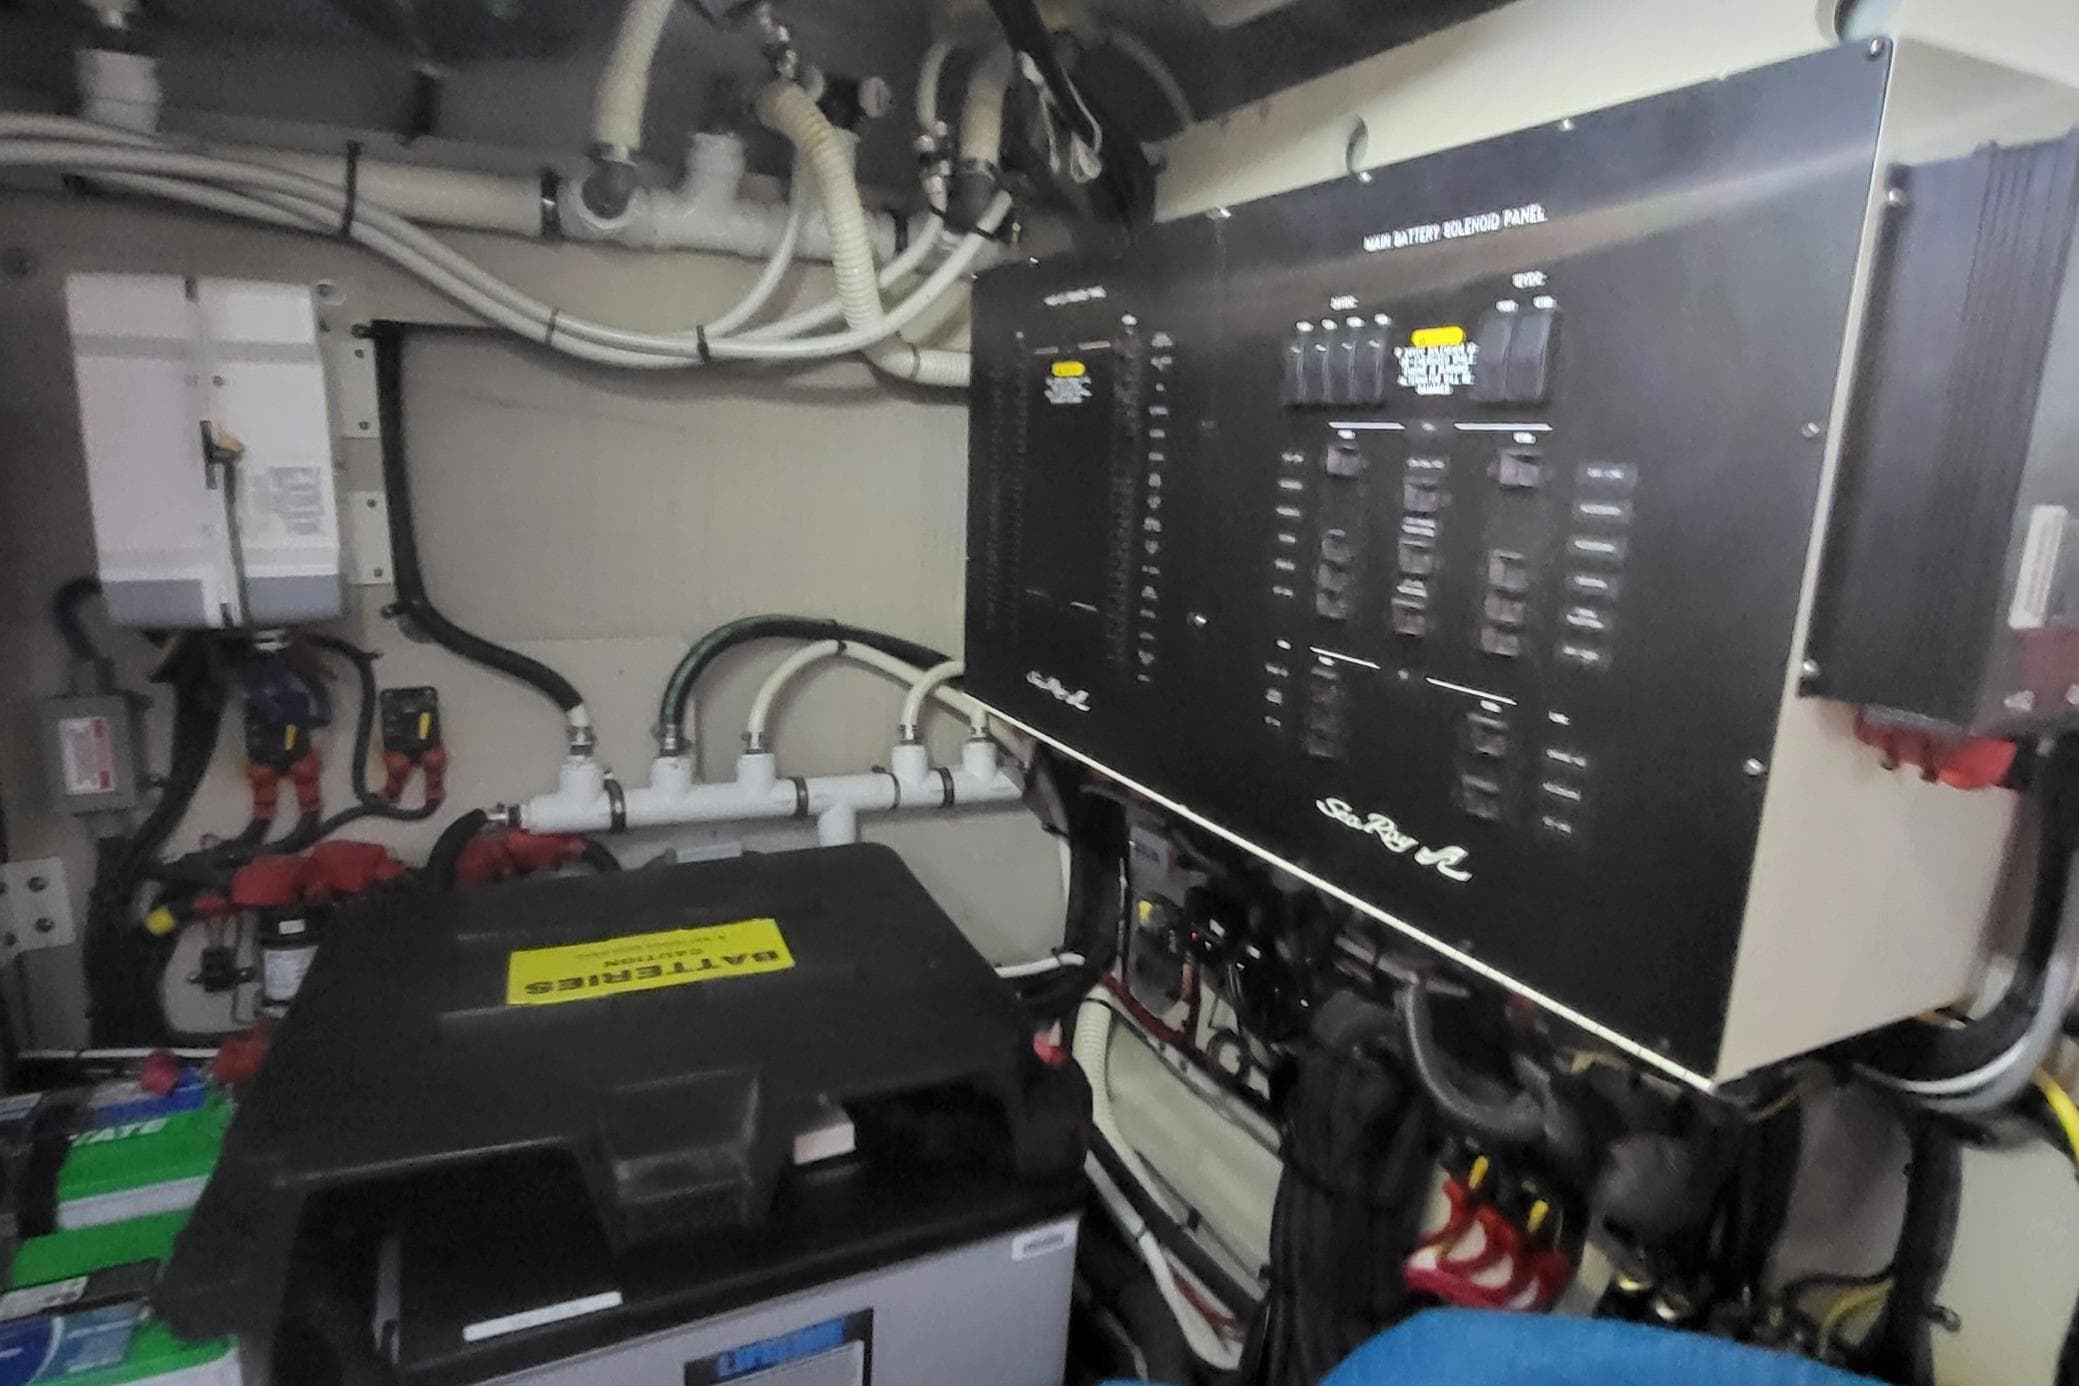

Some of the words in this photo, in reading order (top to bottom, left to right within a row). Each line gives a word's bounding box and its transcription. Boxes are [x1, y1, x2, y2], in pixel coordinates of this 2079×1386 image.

[1363, 233, 1392, 252] MAIN
[1393, 223, 1441, 248] BATTERY
[1443, 212, 1500, 238] SOLENOID
[1503, 202, 1548, 228] PANEL
[524, 949, 779, 995] BATTERIES
